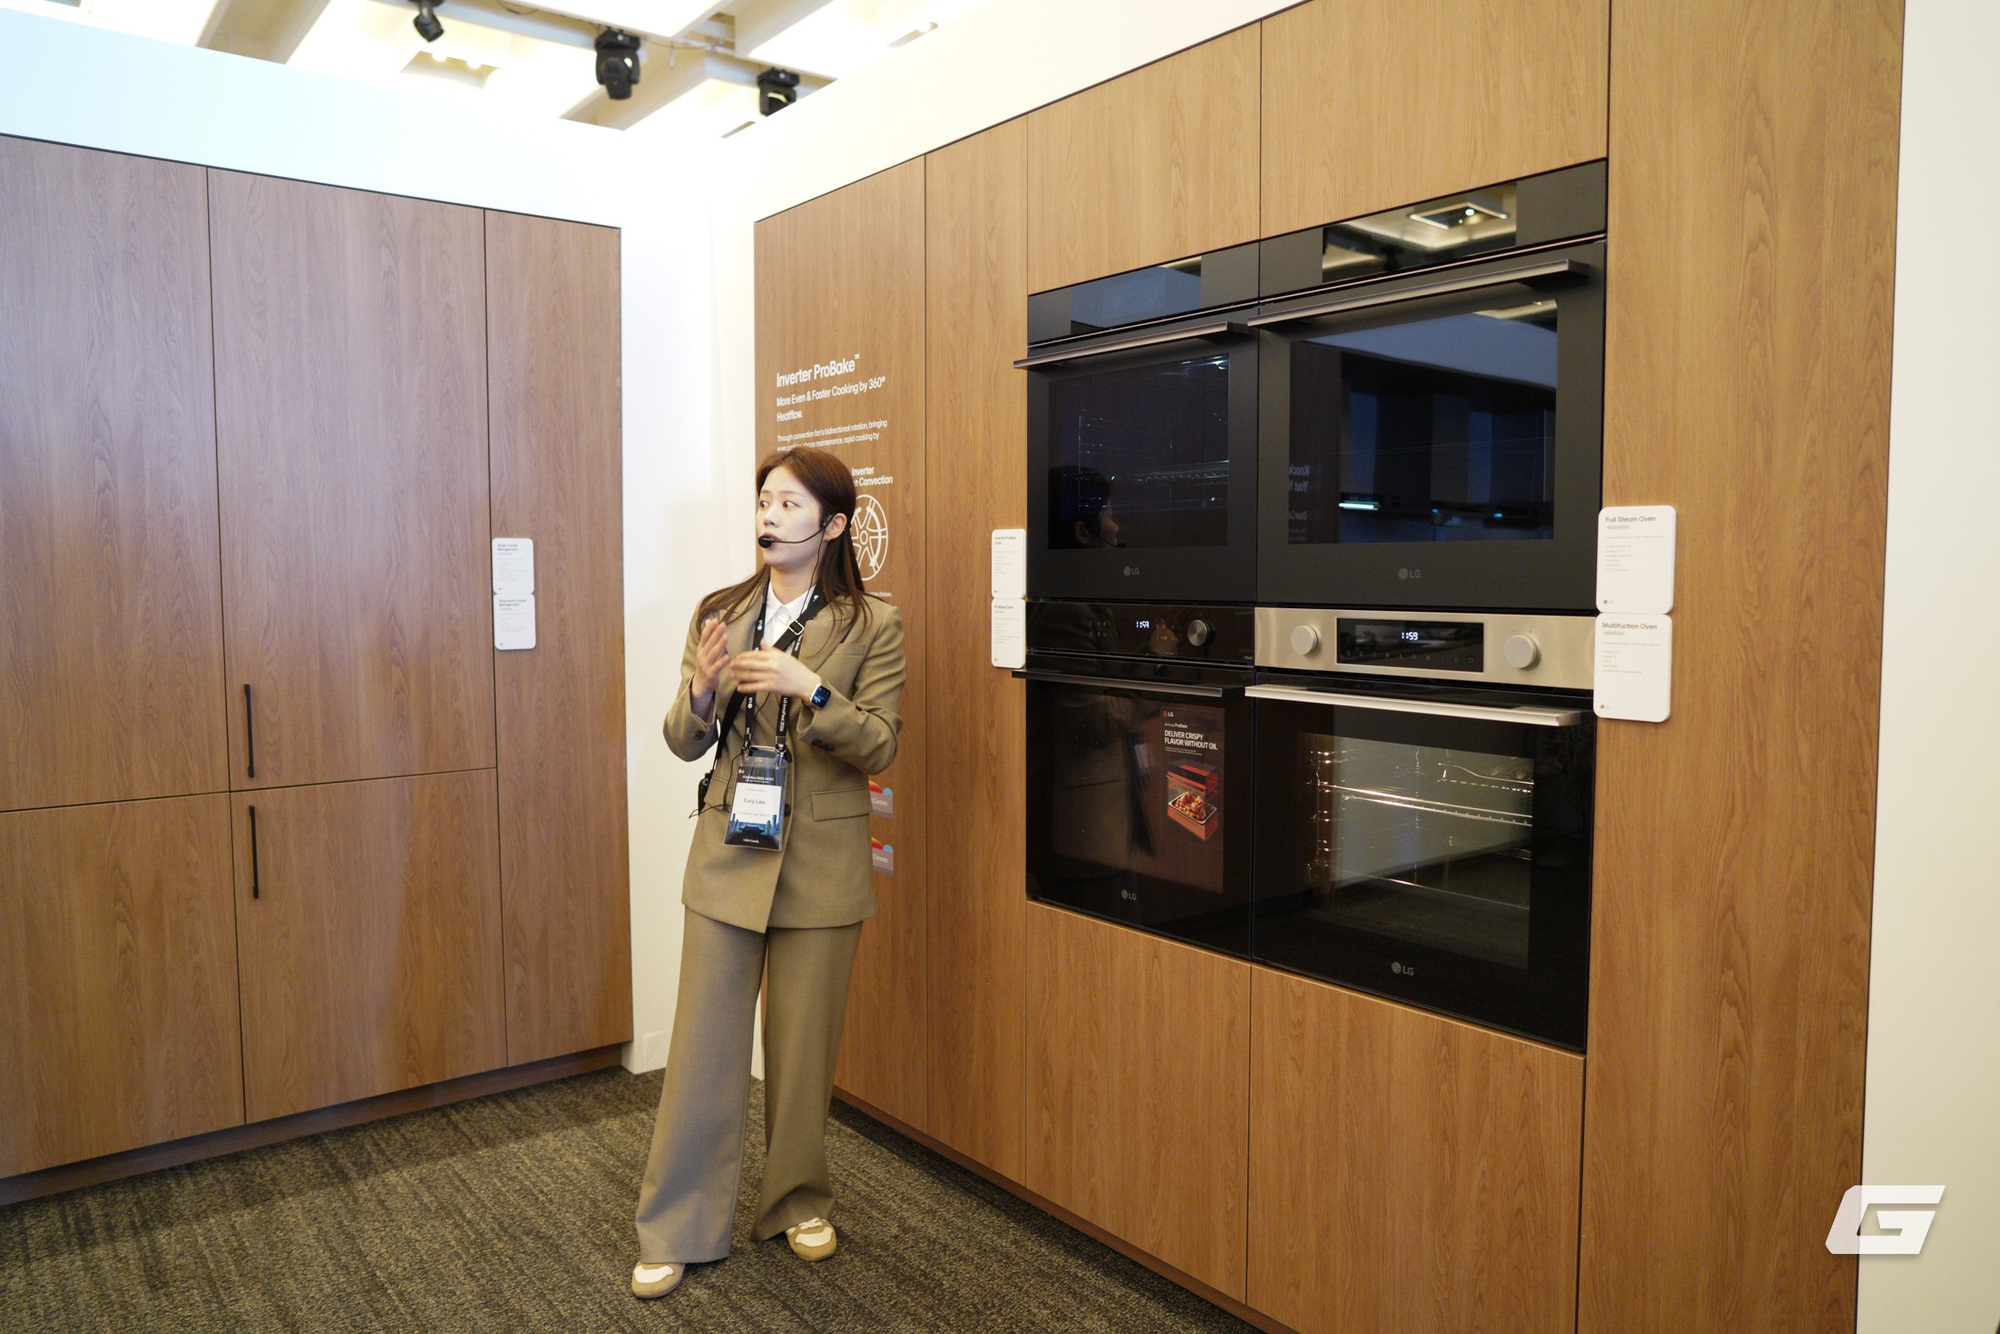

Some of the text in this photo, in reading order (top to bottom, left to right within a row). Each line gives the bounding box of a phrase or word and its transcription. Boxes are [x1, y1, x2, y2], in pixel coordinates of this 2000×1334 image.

[776, 368, 813, 388] Inverter
[776, 396, 791, 407] More
[791, 393, 806, 404] Even
[806, 391, 812, 402] &
[812, 388, 831, 400] Faster
[832, 383, 859, 396] Cooking
[859, 381, 868, 393] by
[776, 409, 803, 422] Heatflow.
[868, 420, 888, 429] bringing
[872, 432, 880, 440] by
[852, 466, 874, 476] Inverter
[858, 474, 893, 486] Convection
[1132, 567, 1140, 575] LG
[1410, 569, 1421, 578] LG
[1402, 631, 1418, 640] 11:59
[1164, 730, 1204, 740] DELIVER CRISPY
[1164, 737, 1218, 750] FLAVOR WITHOUT OIL
[1129, 892, 1136, 901] LG
[1402, 965, 1414, 976] LG
